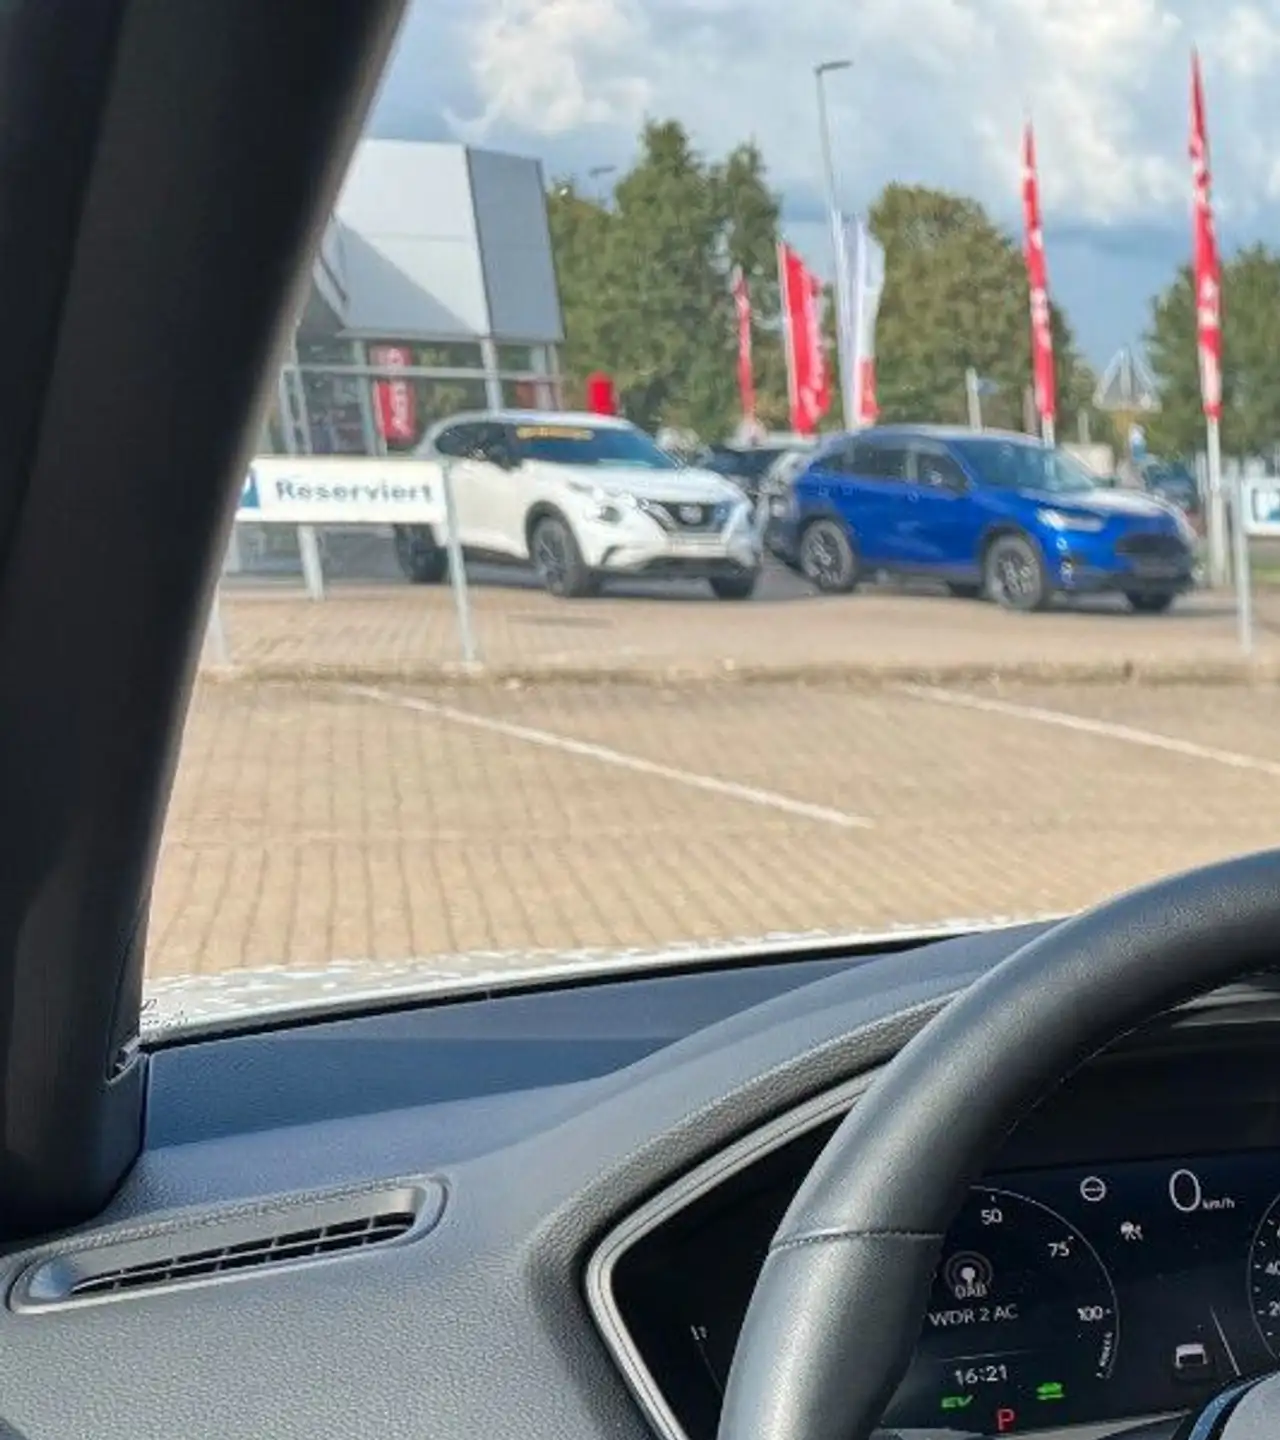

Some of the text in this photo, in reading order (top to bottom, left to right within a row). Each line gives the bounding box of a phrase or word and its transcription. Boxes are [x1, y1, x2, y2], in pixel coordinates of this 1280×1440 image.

[275, 478, 434, 502] Reserviert
[1168, 1168, 1235, 1212] 0 km/h
[980, 1209, 1003, 1226] 50
[1048, 1242, 1070, 1258] 75
[928, 1303, 1020, 1328] WDR 2 AC
[1077, 1306, 1103, 1323] 100
[954, 1363, 1008, 1386] 16:21
[940, 1394, 974, 1409] EV
[996, 1408, 1015, 1431] P
